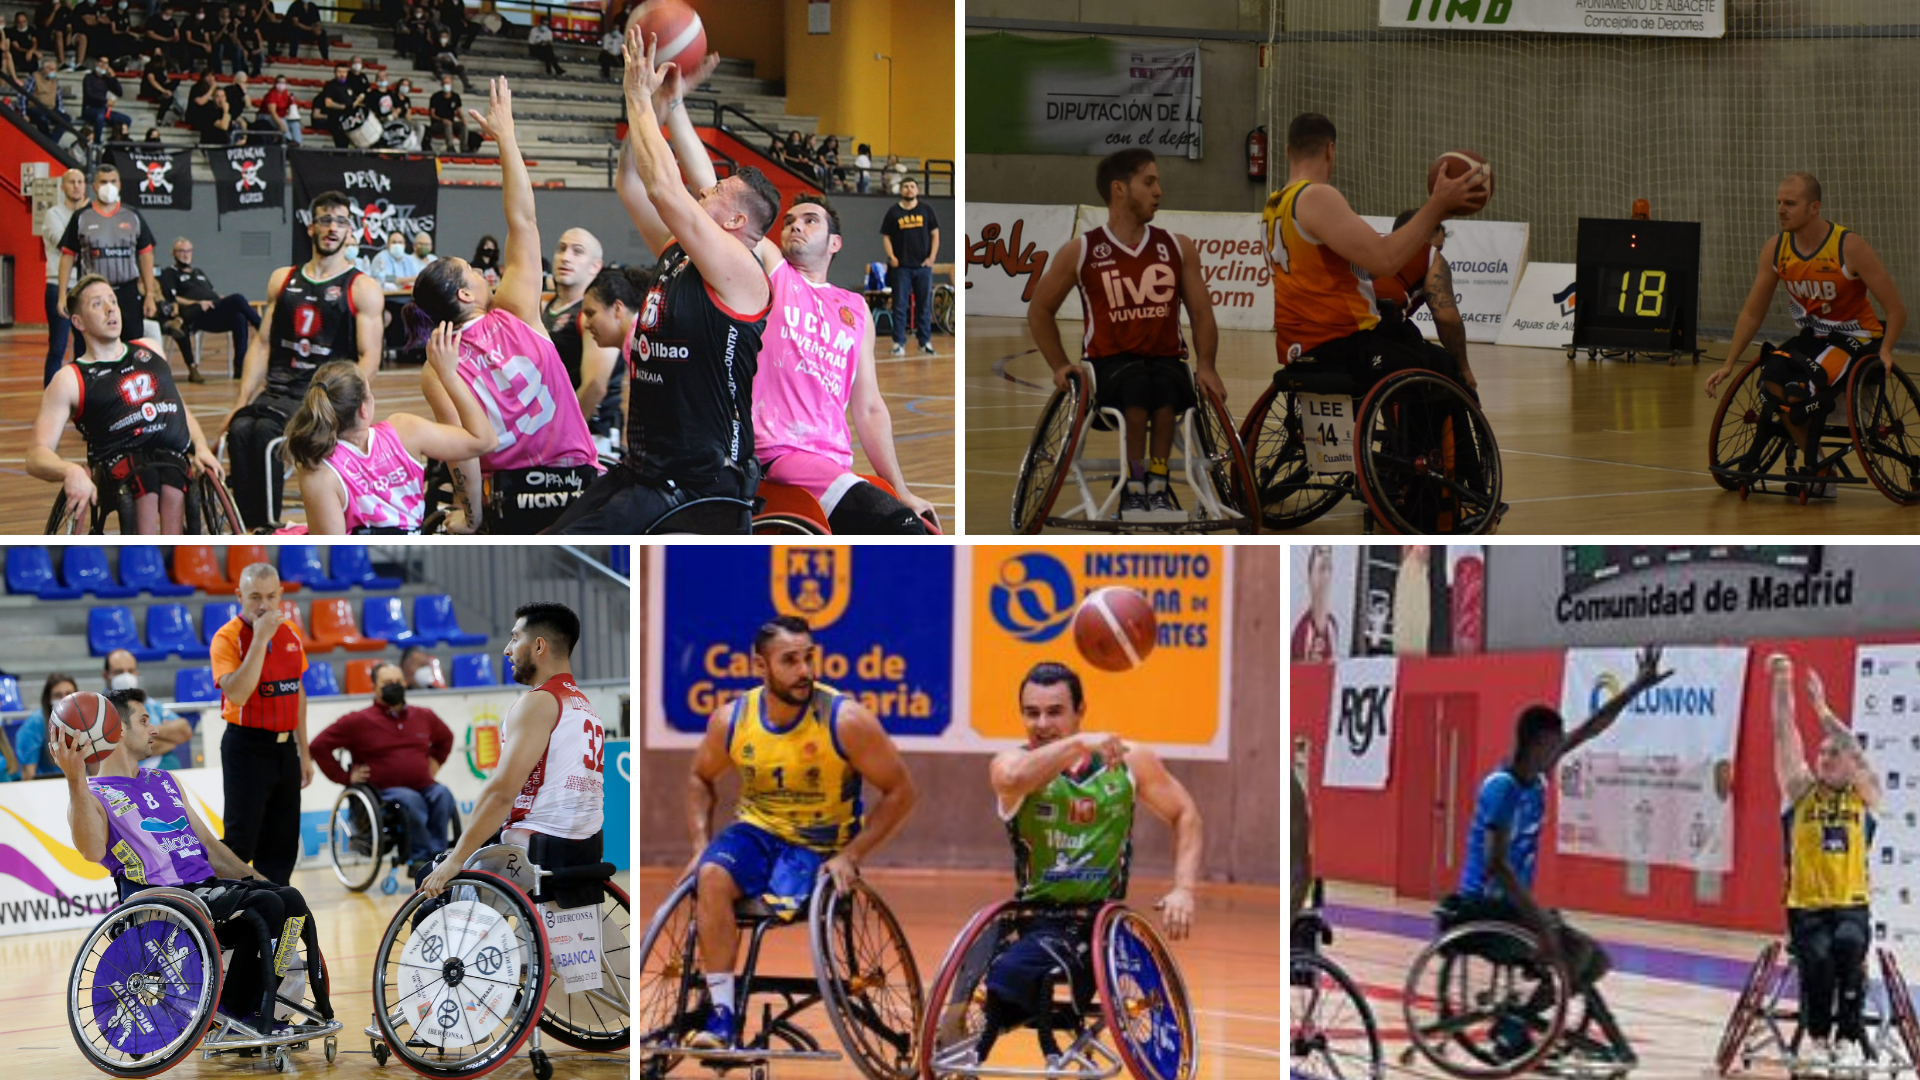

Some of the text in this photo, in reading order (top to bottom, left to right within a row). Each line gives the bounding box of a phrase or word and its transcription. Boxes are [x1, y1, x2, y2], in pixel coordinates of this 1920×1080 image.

[1584, 14, 1705, 32] Concejalía de Deportes
[1046, 98, 1153, 122] DIPUTACIÓN
[1157, 103, 1180, 122] DE
[1105, 132, 1133, 146] con
[1138, 127, 1155, 146] el
[1101, 263, 1176, 309] live
[1618, 269, 1667, 318] 18
[302, 308, 315, 335] 7
[1513, 317, 1551, 332] Aguas
[1552, 319, 1560, 331] de
[121, 373, 155, 403] 12
[1309, 400, 1344, 418] LEE
[1805, 400, 1820, 414] FIX
[1317, 422, 1339, 447] 14
[516, 491, 569, 509] VICKY
[1083, 552, 1211, 579] INSTITUTO
[1555, 567, 1855, 624] Comunidad de Madrid
[856, 640, 907, 680] de
[771, 766, 785, 789] 1
[142, 791, 160, 810] 8
[556, 911, 594, 924] IBERCONSA
[144, 940, 187, 996] MICHELIN
